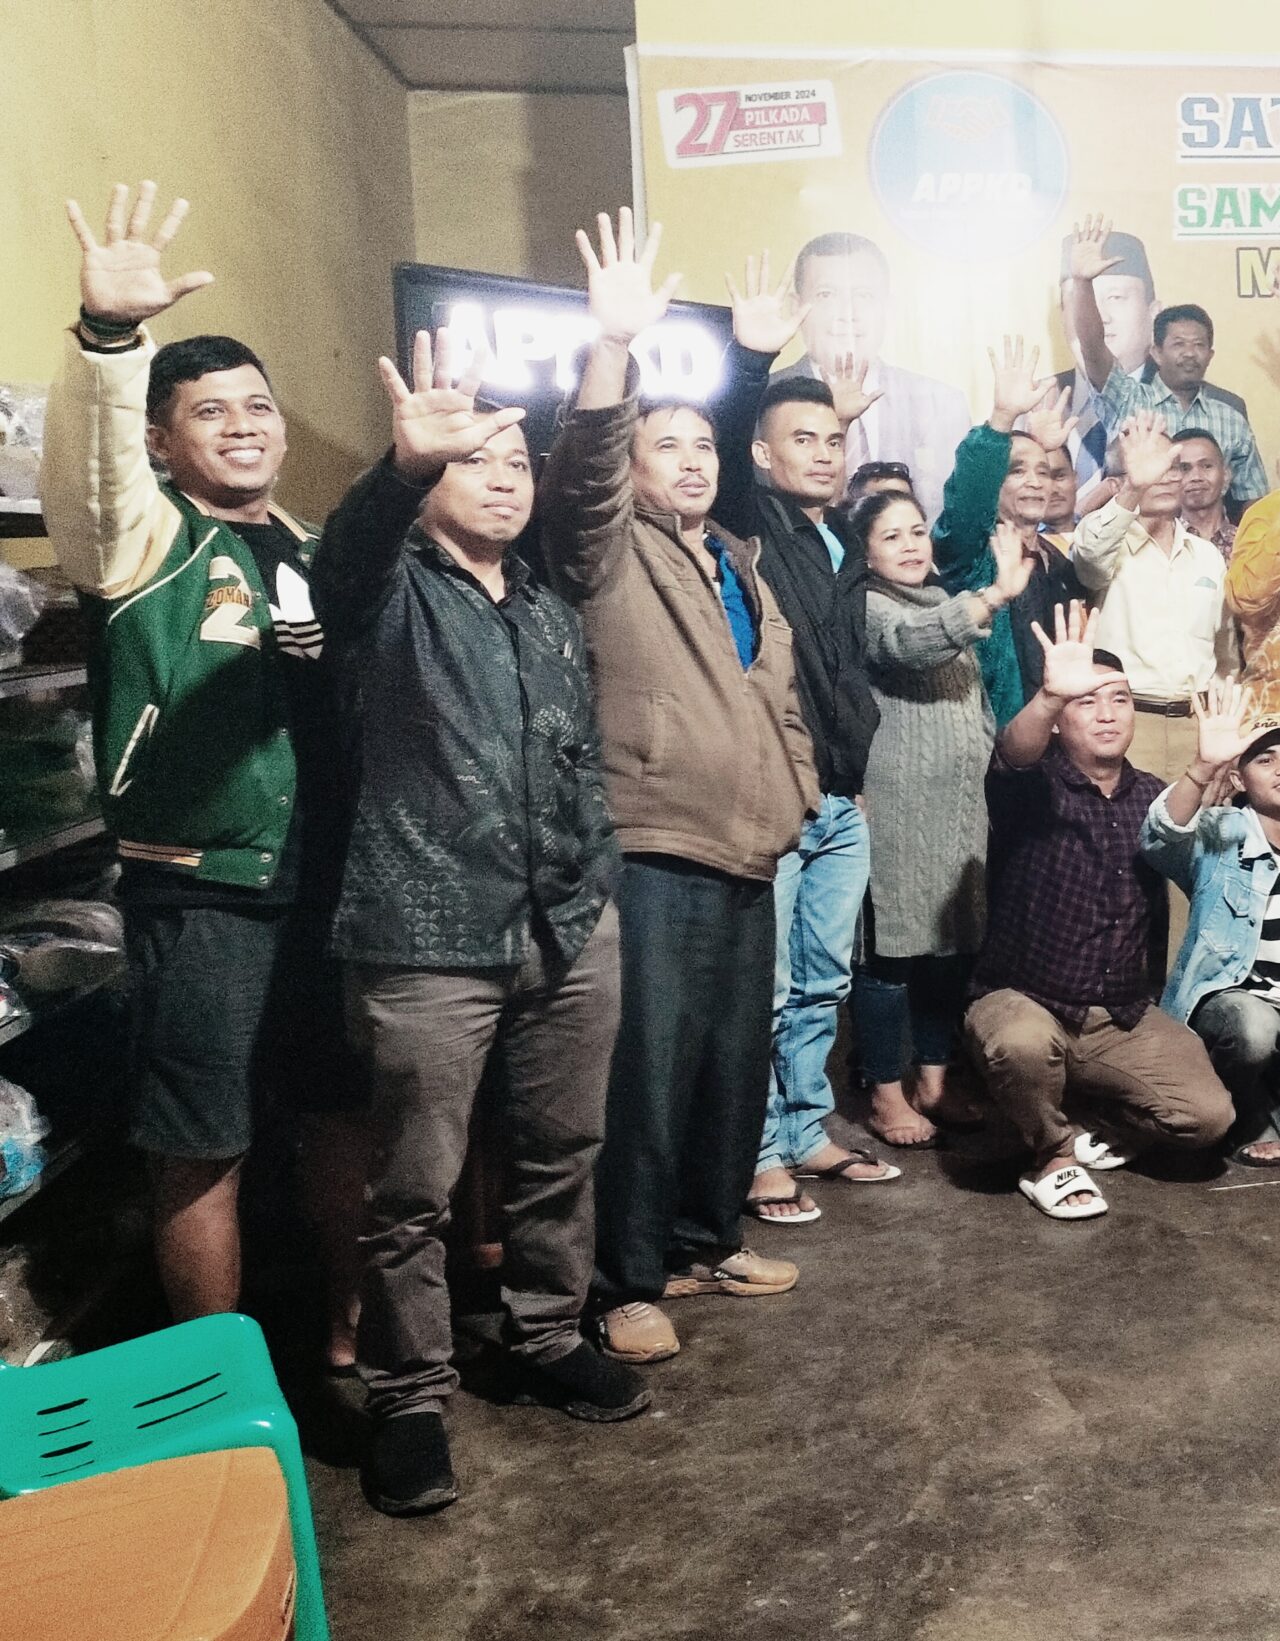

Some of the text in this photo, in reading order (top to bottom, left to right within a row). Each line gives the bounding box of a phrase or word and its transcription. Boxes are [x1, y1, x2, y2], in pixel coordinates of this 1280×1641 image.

[745, 89, 817, 102] NOVEMBER 2024
[674, 91, 741, 157] 27
[745, 106, 812, 126] PILKADA
[733, 129, 805, 148] SERENTAK
[1057, 1169, 1079, 1182] NIKE
